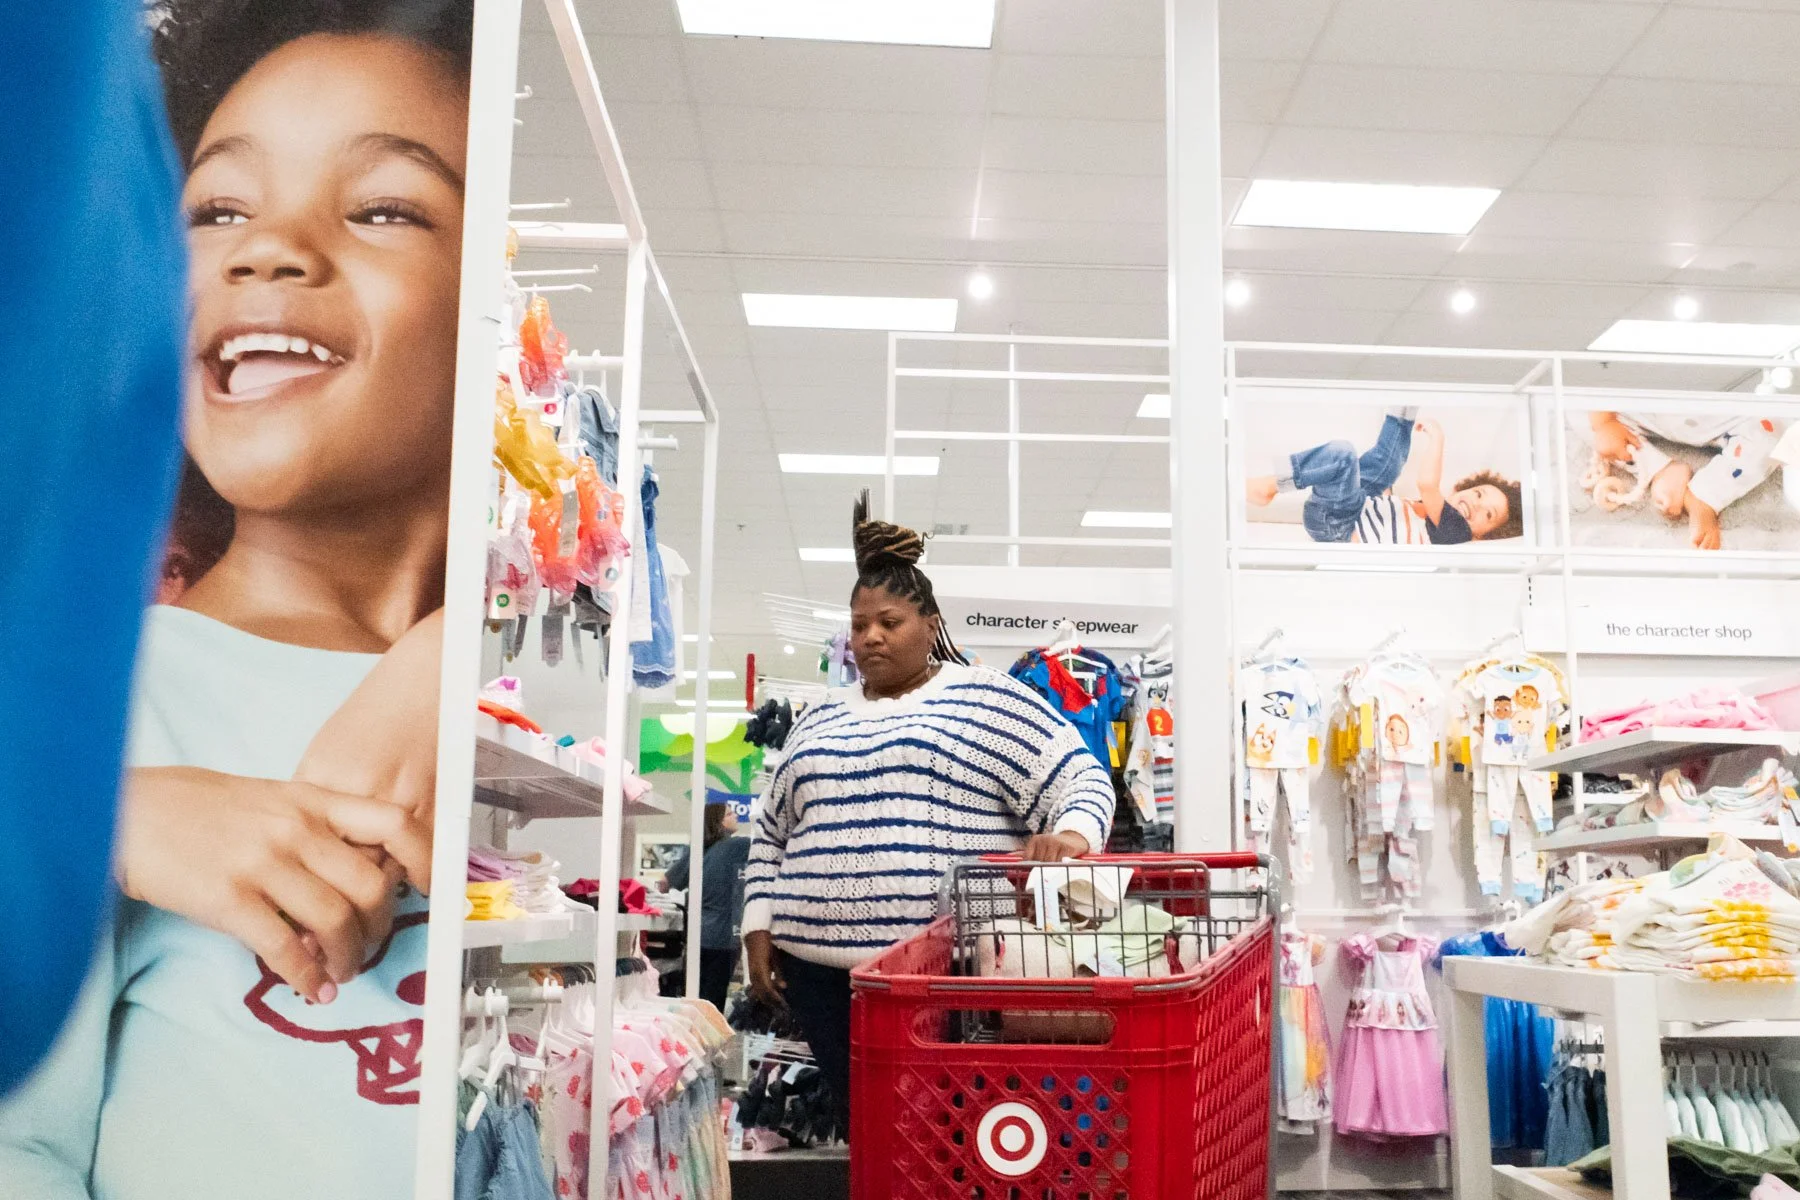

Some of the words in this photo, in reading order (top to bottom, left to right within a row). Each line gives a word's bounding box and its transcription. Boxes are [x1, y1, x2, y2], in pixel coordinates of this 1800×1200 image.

[966, 612, 1049, 629] character
[1052, 616, 1139, 635] sepwear
[1606, 623, 1631, 636] the
[1635, 623, 1711, 637] character
[1715, 625, 1753, 641] shop
[1154, 715, 1164, 732] 2
